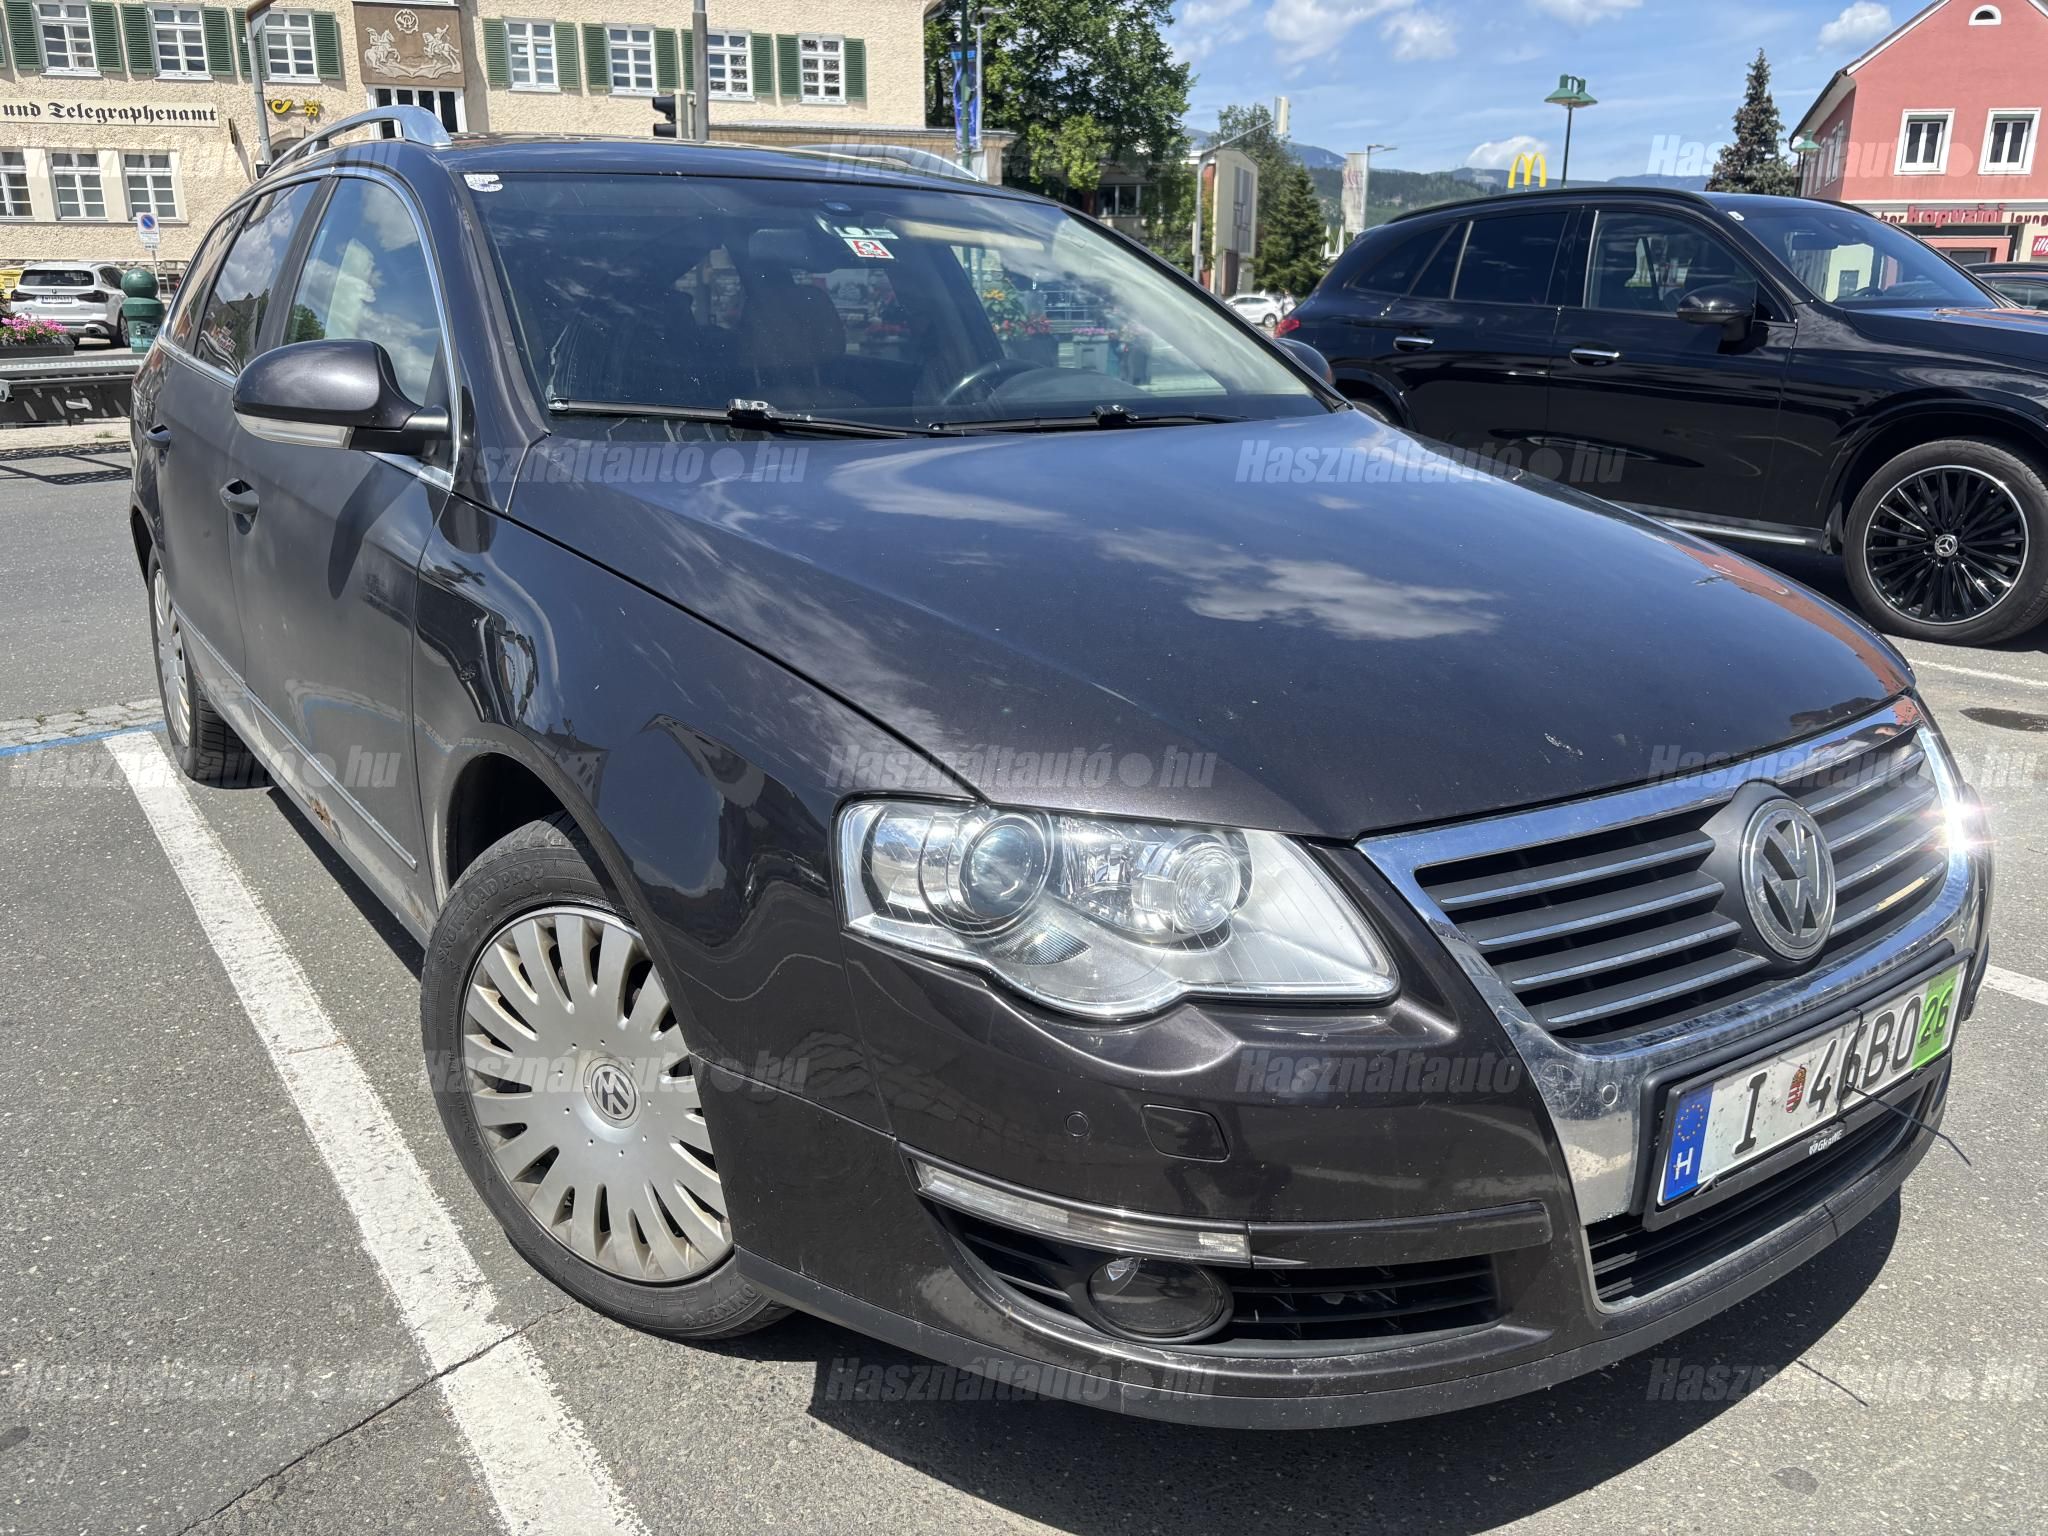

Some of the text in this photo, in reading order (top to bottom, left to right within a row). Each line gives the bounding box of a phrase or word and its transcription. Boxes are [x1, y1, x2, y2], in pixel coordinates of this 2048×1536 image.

[2, 102, 218, 124] und Telegraphenamt
[1919, 986, 1953, 1047] 26
[1674, 1147, 1693, 1180] H
